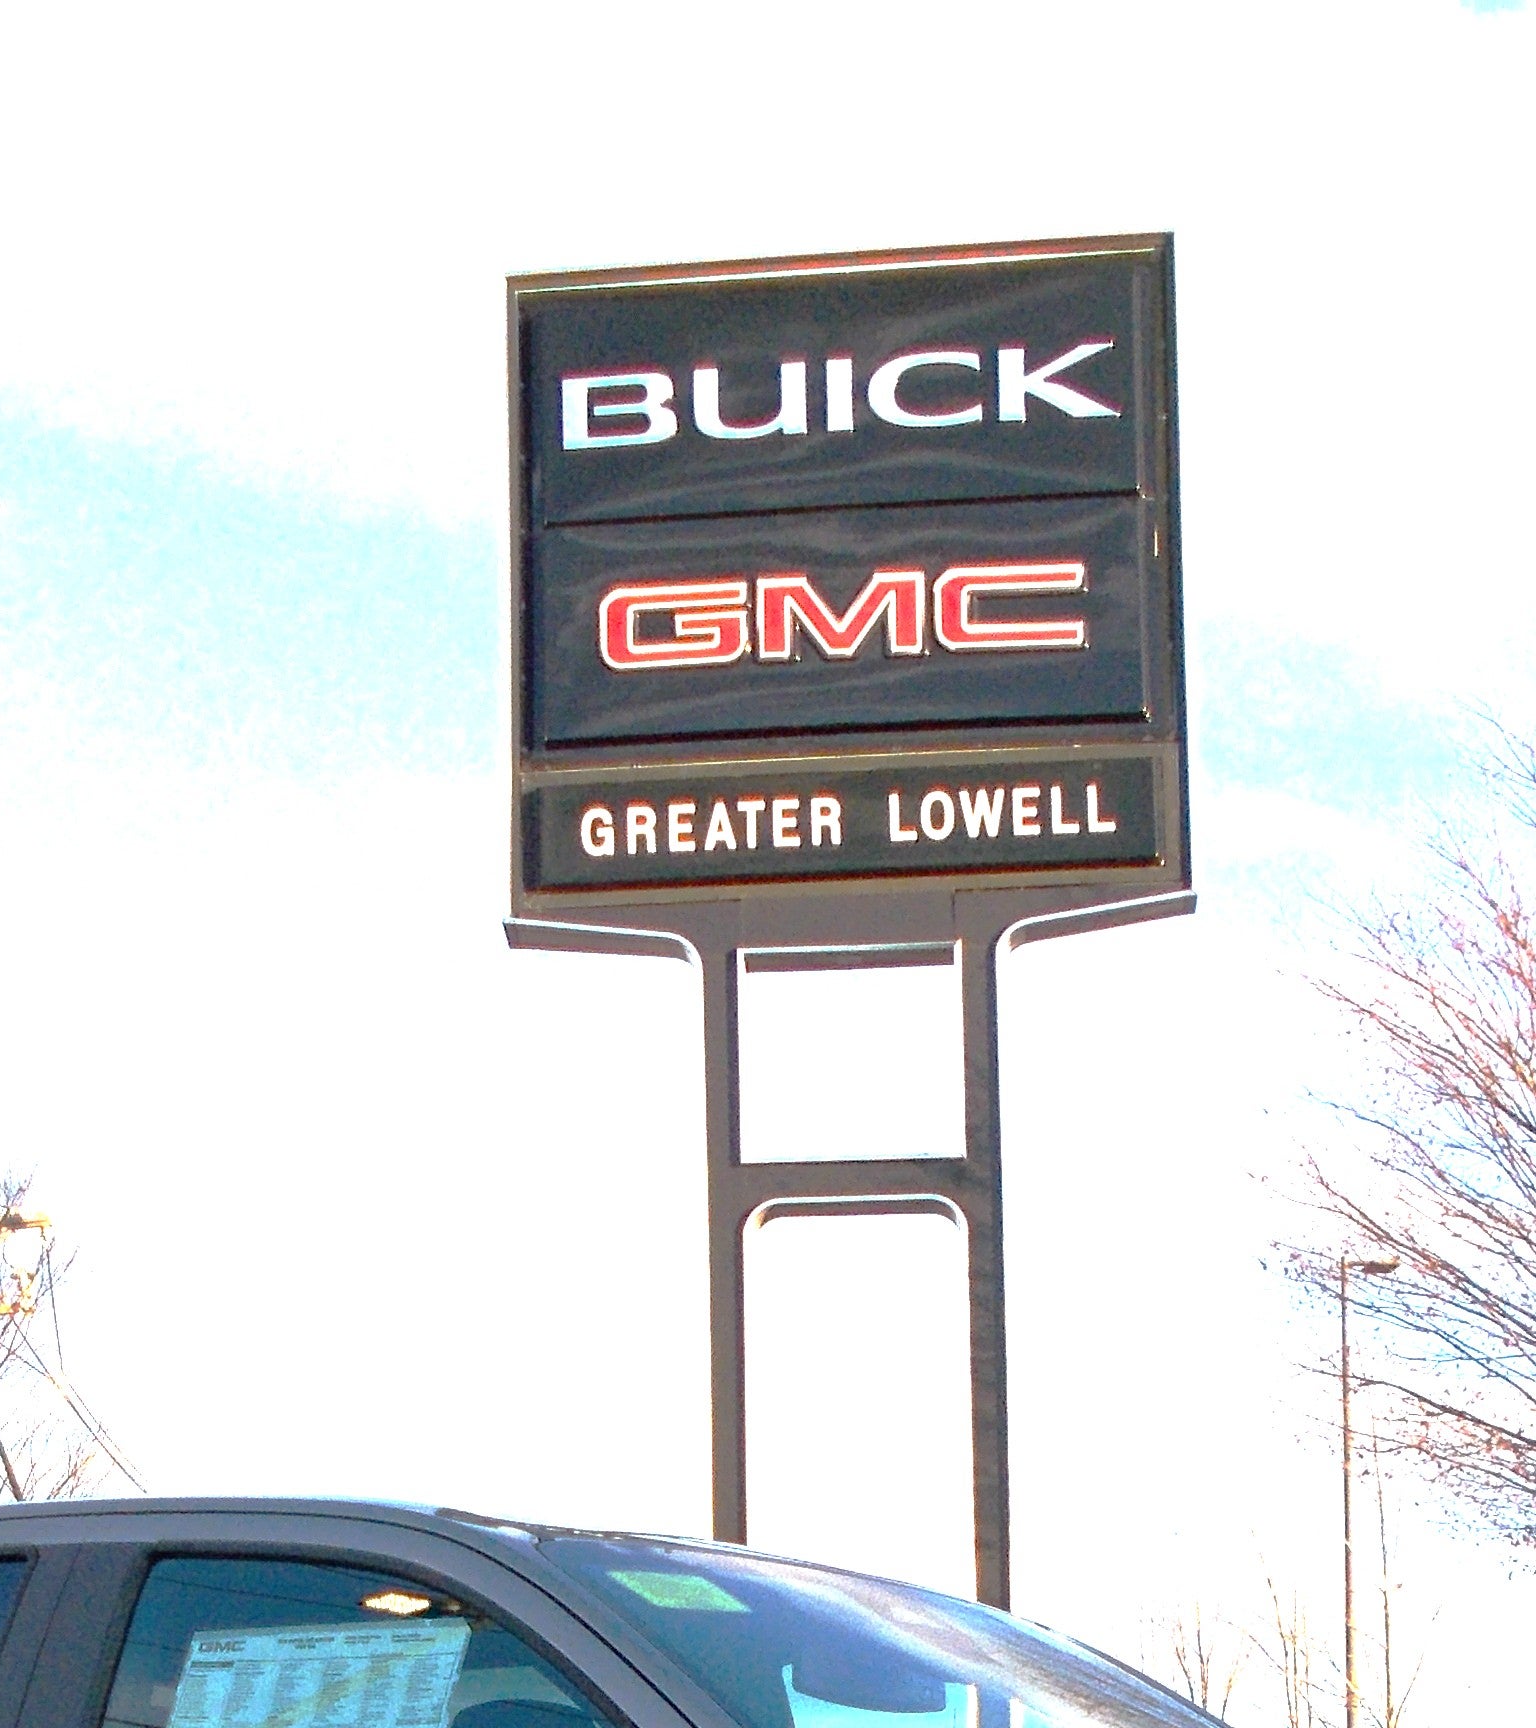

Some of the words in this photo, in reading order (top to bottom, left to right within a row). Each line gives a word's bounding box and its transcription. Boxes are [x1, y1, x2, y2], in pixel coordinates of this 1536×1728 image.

[562, 340, 1121, 451] BUICK
[599, 562, 1089, 670] GMC
[579, 795, 843, 857] GREATER
[887, 783, 1118, 843] LOWELL
